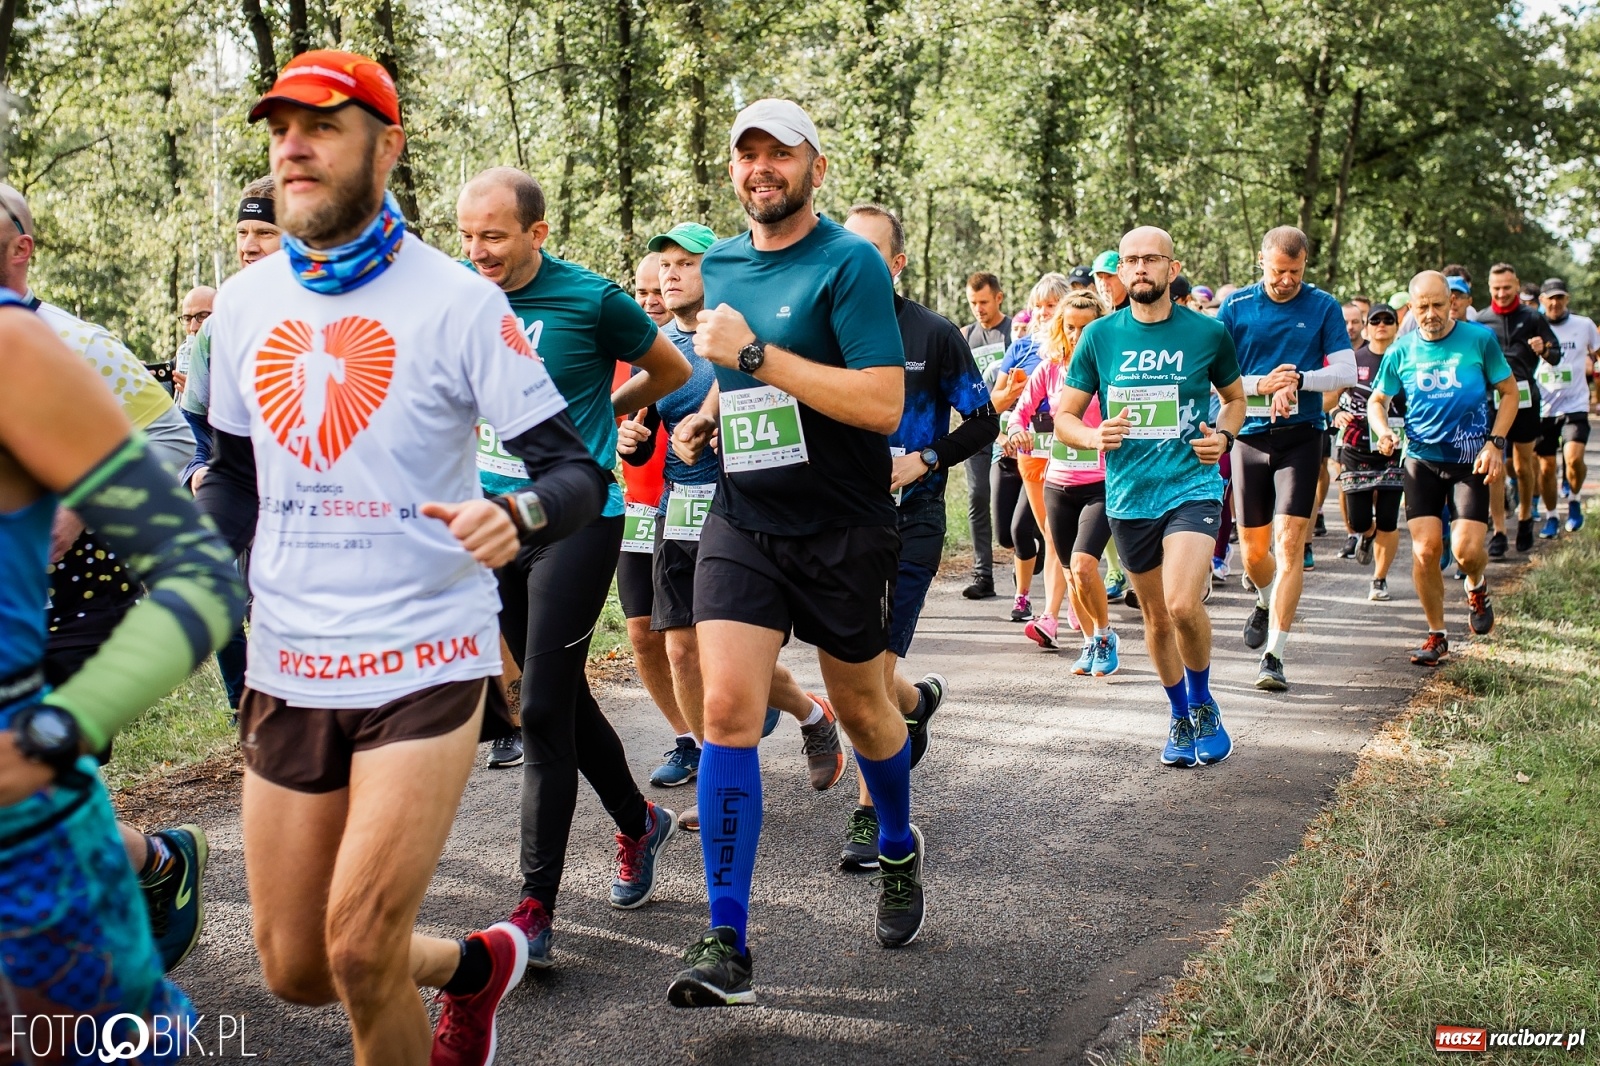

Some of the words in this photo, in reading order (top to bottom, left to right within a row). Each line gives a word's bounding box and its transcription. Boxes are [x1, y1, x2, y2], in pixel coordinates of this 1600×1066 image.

[1119, 349, 1184, 373] ZBM
[1170, 373, 1187, 381] Team
[1416, 365, 1463, 392] bbl
[1126, 403, 1158, 426] 57
[729, 413, 780, 451] 134
[296, 481, 344, 496] fundacja
[309, 505, 318, 517] z
[343, 539, 373, 549] 2013
[279, 649, 404, 681] RYSZARD
[415, 633, 481, 670] RUN
